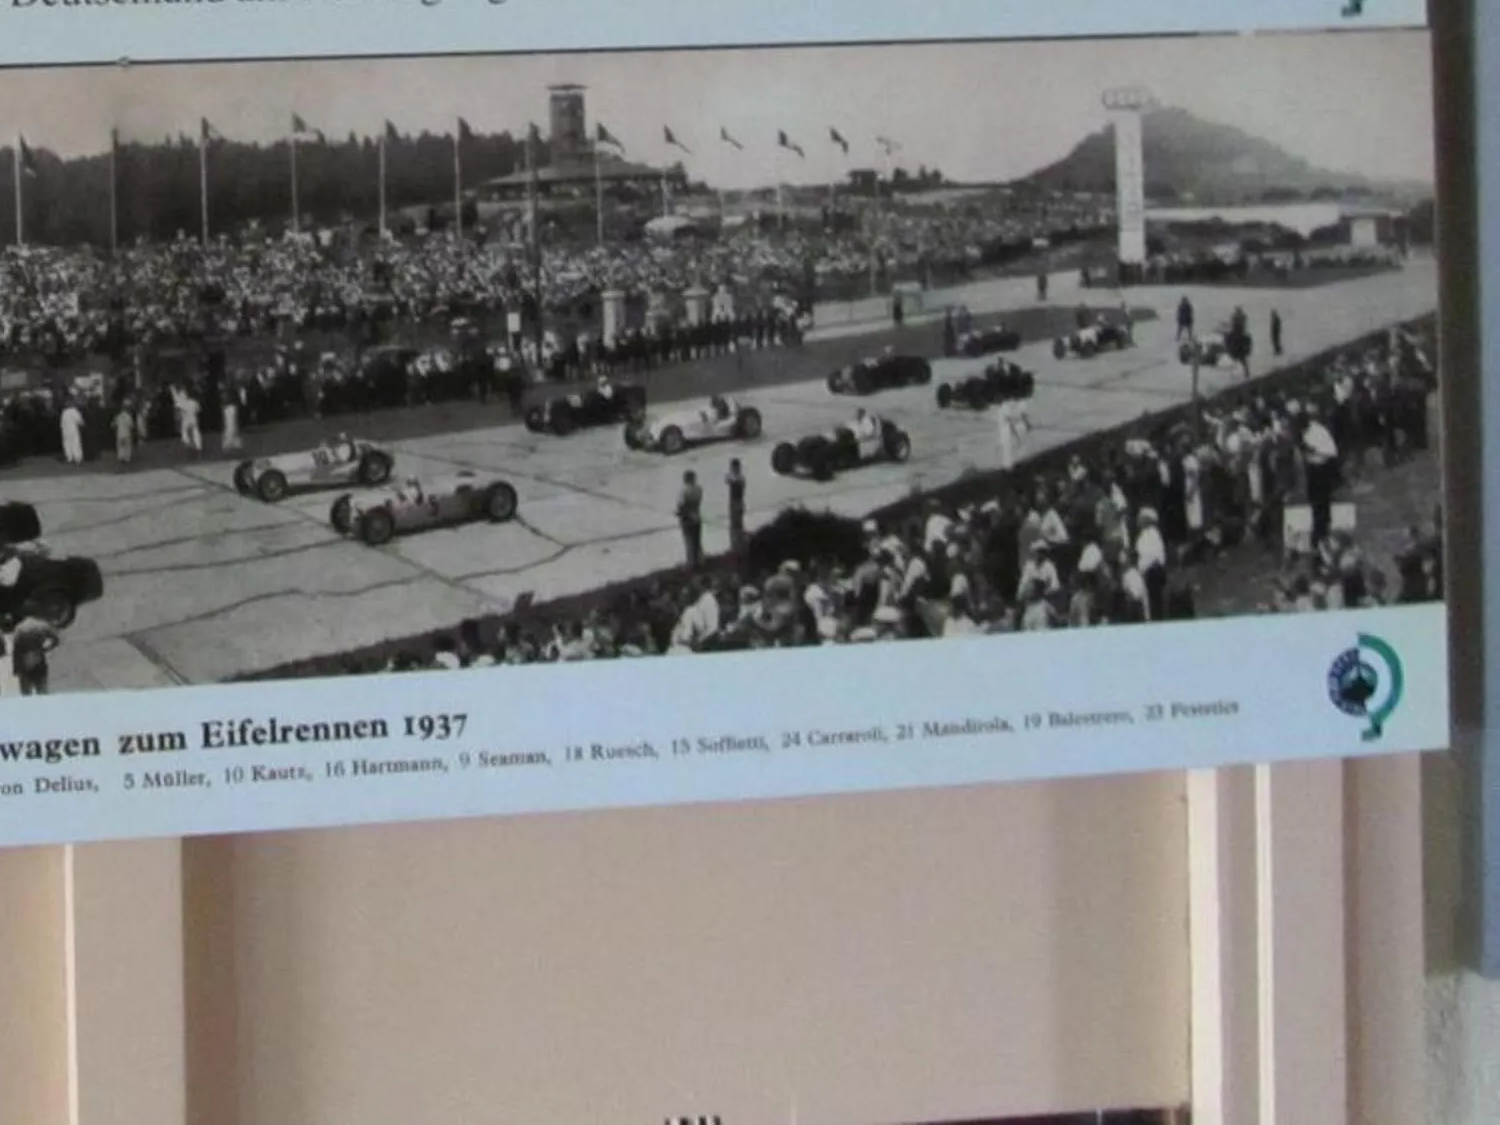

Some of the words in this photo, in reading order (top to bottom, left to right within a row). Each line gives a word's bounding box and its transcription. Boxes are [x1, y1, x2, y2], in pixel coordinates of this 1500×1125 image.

[117, 730, 189, 756] zum
[200, 716, 389, 750] Eifelrennen
[403, 712, 469, 742] 1937
[32, 774, 100, 795] Delius,
[122, 771, 136, 791] 5
[223, 763, 245, 786] 10
[350, 756, 450, 778] Hartmann,
